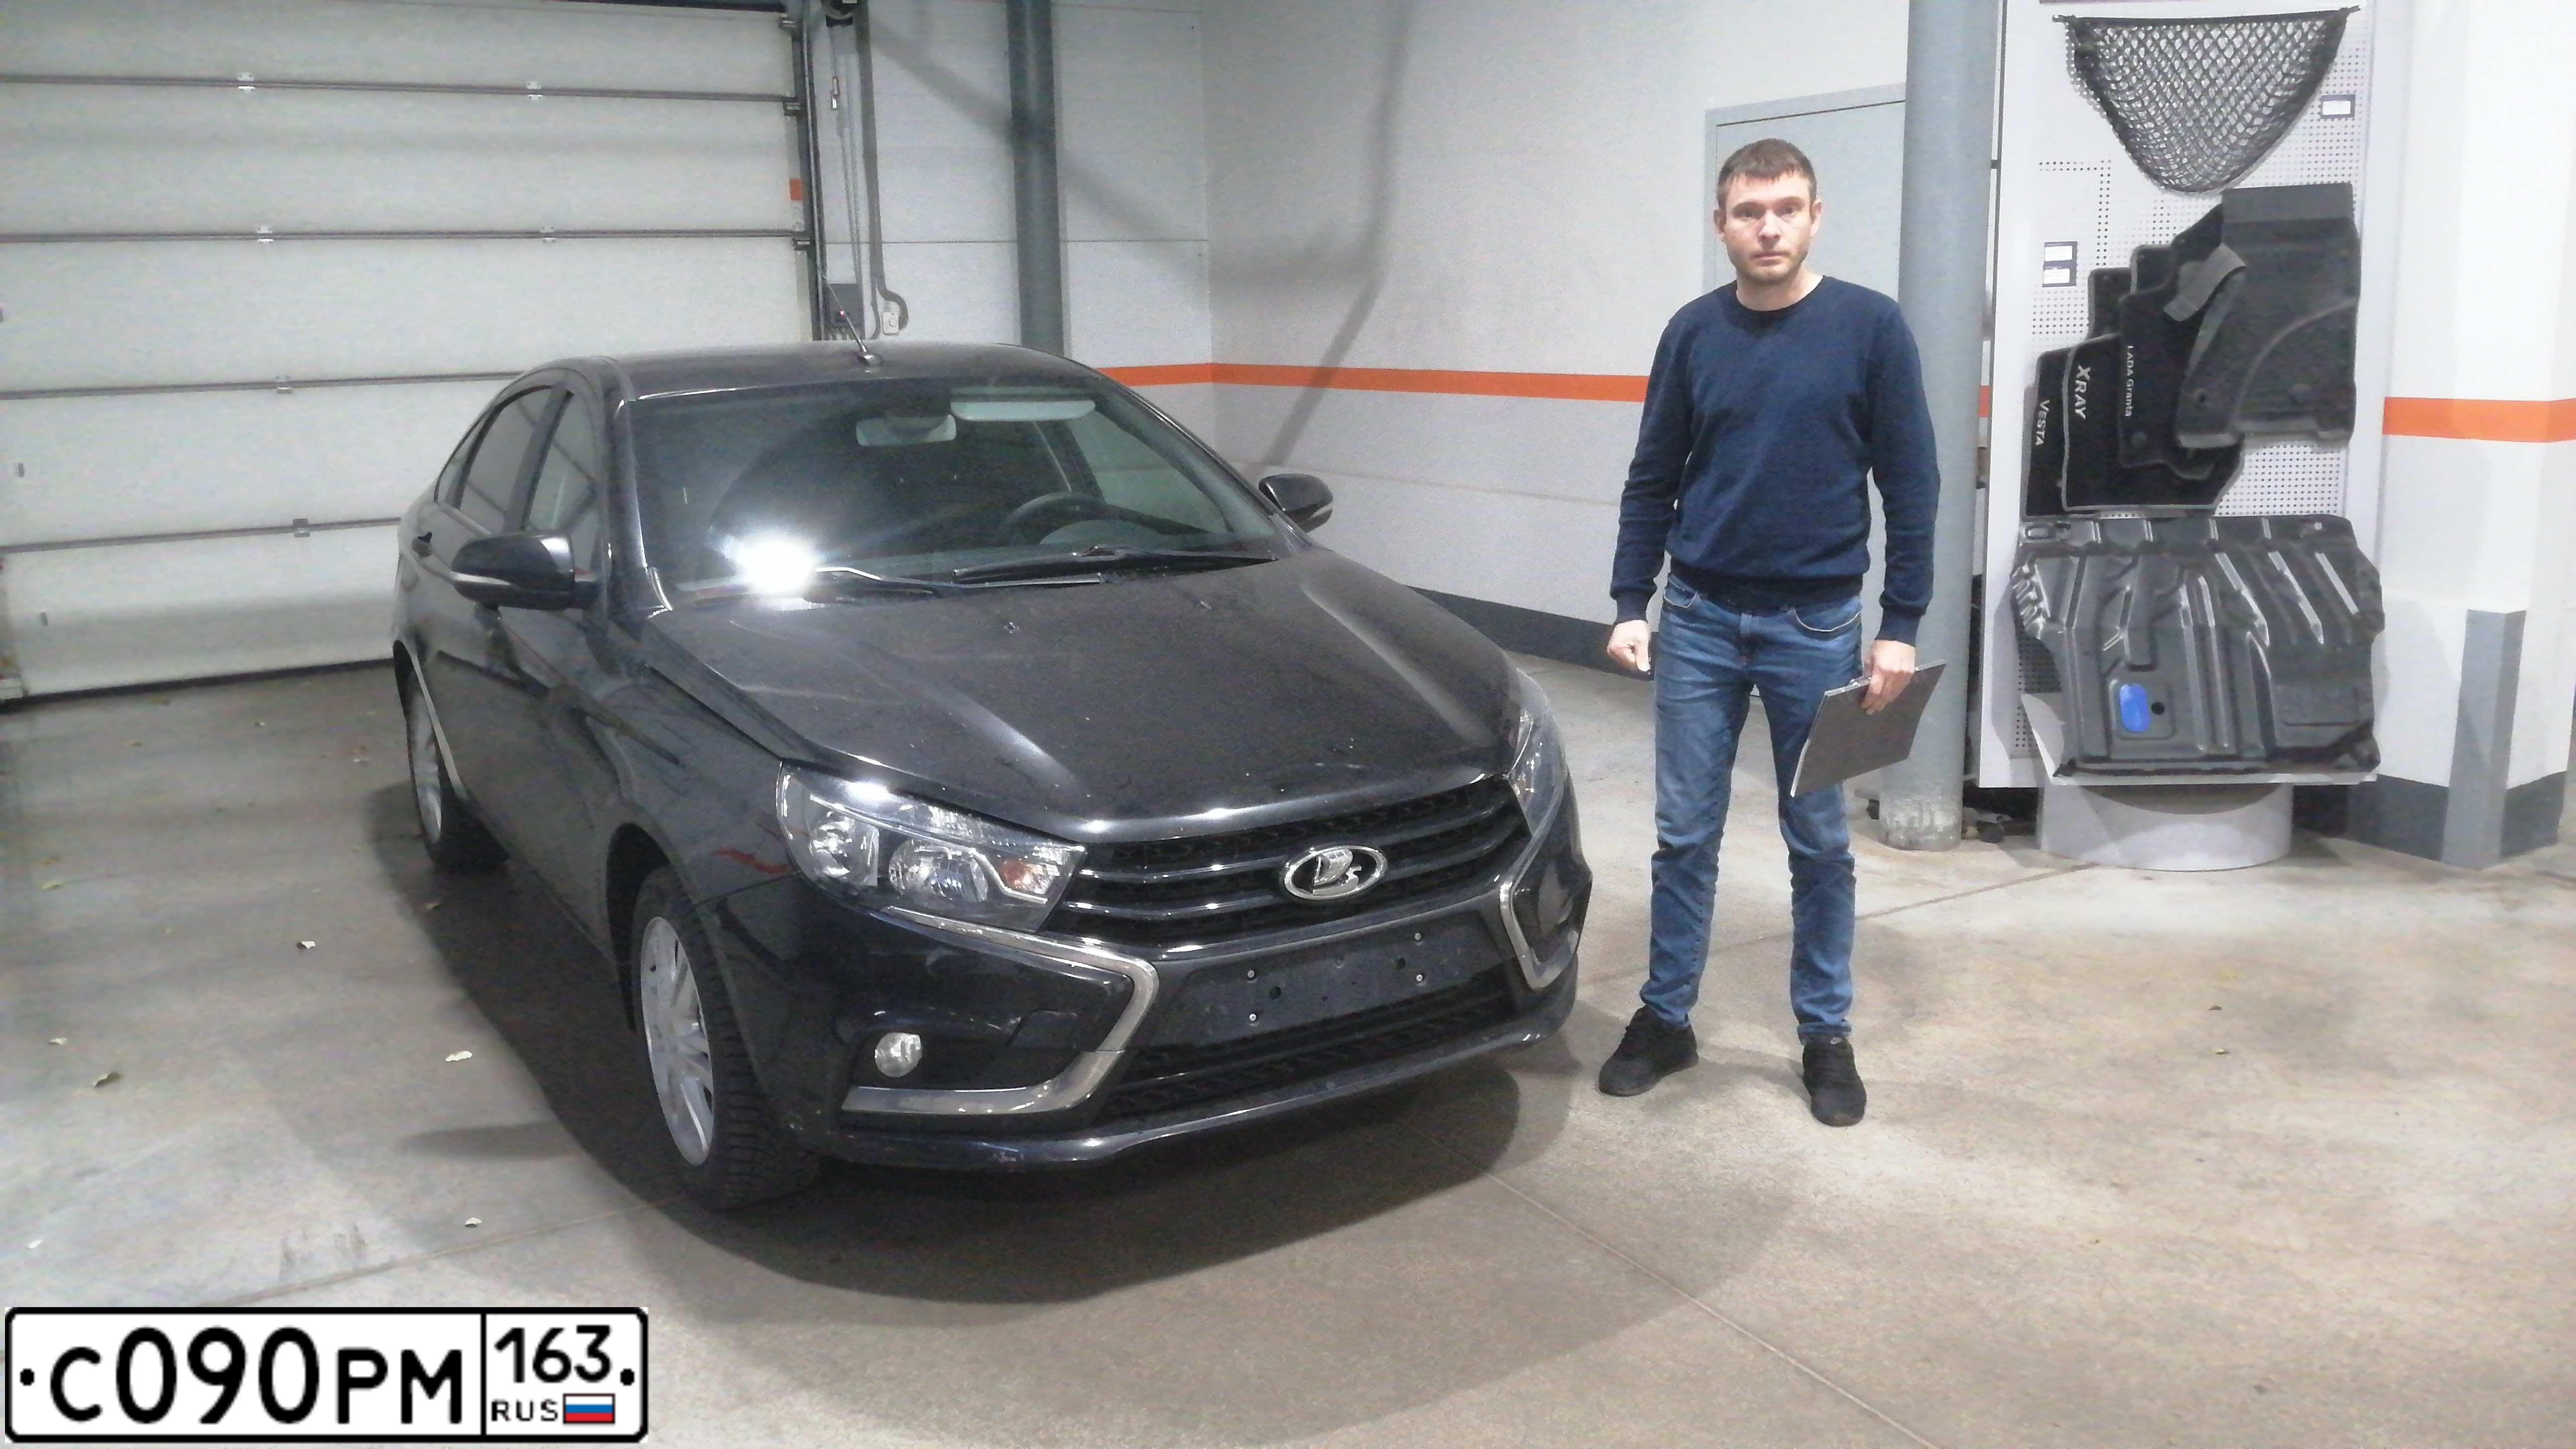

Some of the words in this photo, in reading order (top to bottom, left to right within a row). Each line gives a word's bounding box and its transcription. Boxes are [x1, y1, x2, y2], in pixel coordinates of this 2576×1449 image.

[2126, 345, 2135, 376] LADA
[2074, 364, 2091, 420] XRAY
[2124, 378, 2135, 417] Granta
[2035, 399, 2051, 446] VESTA
